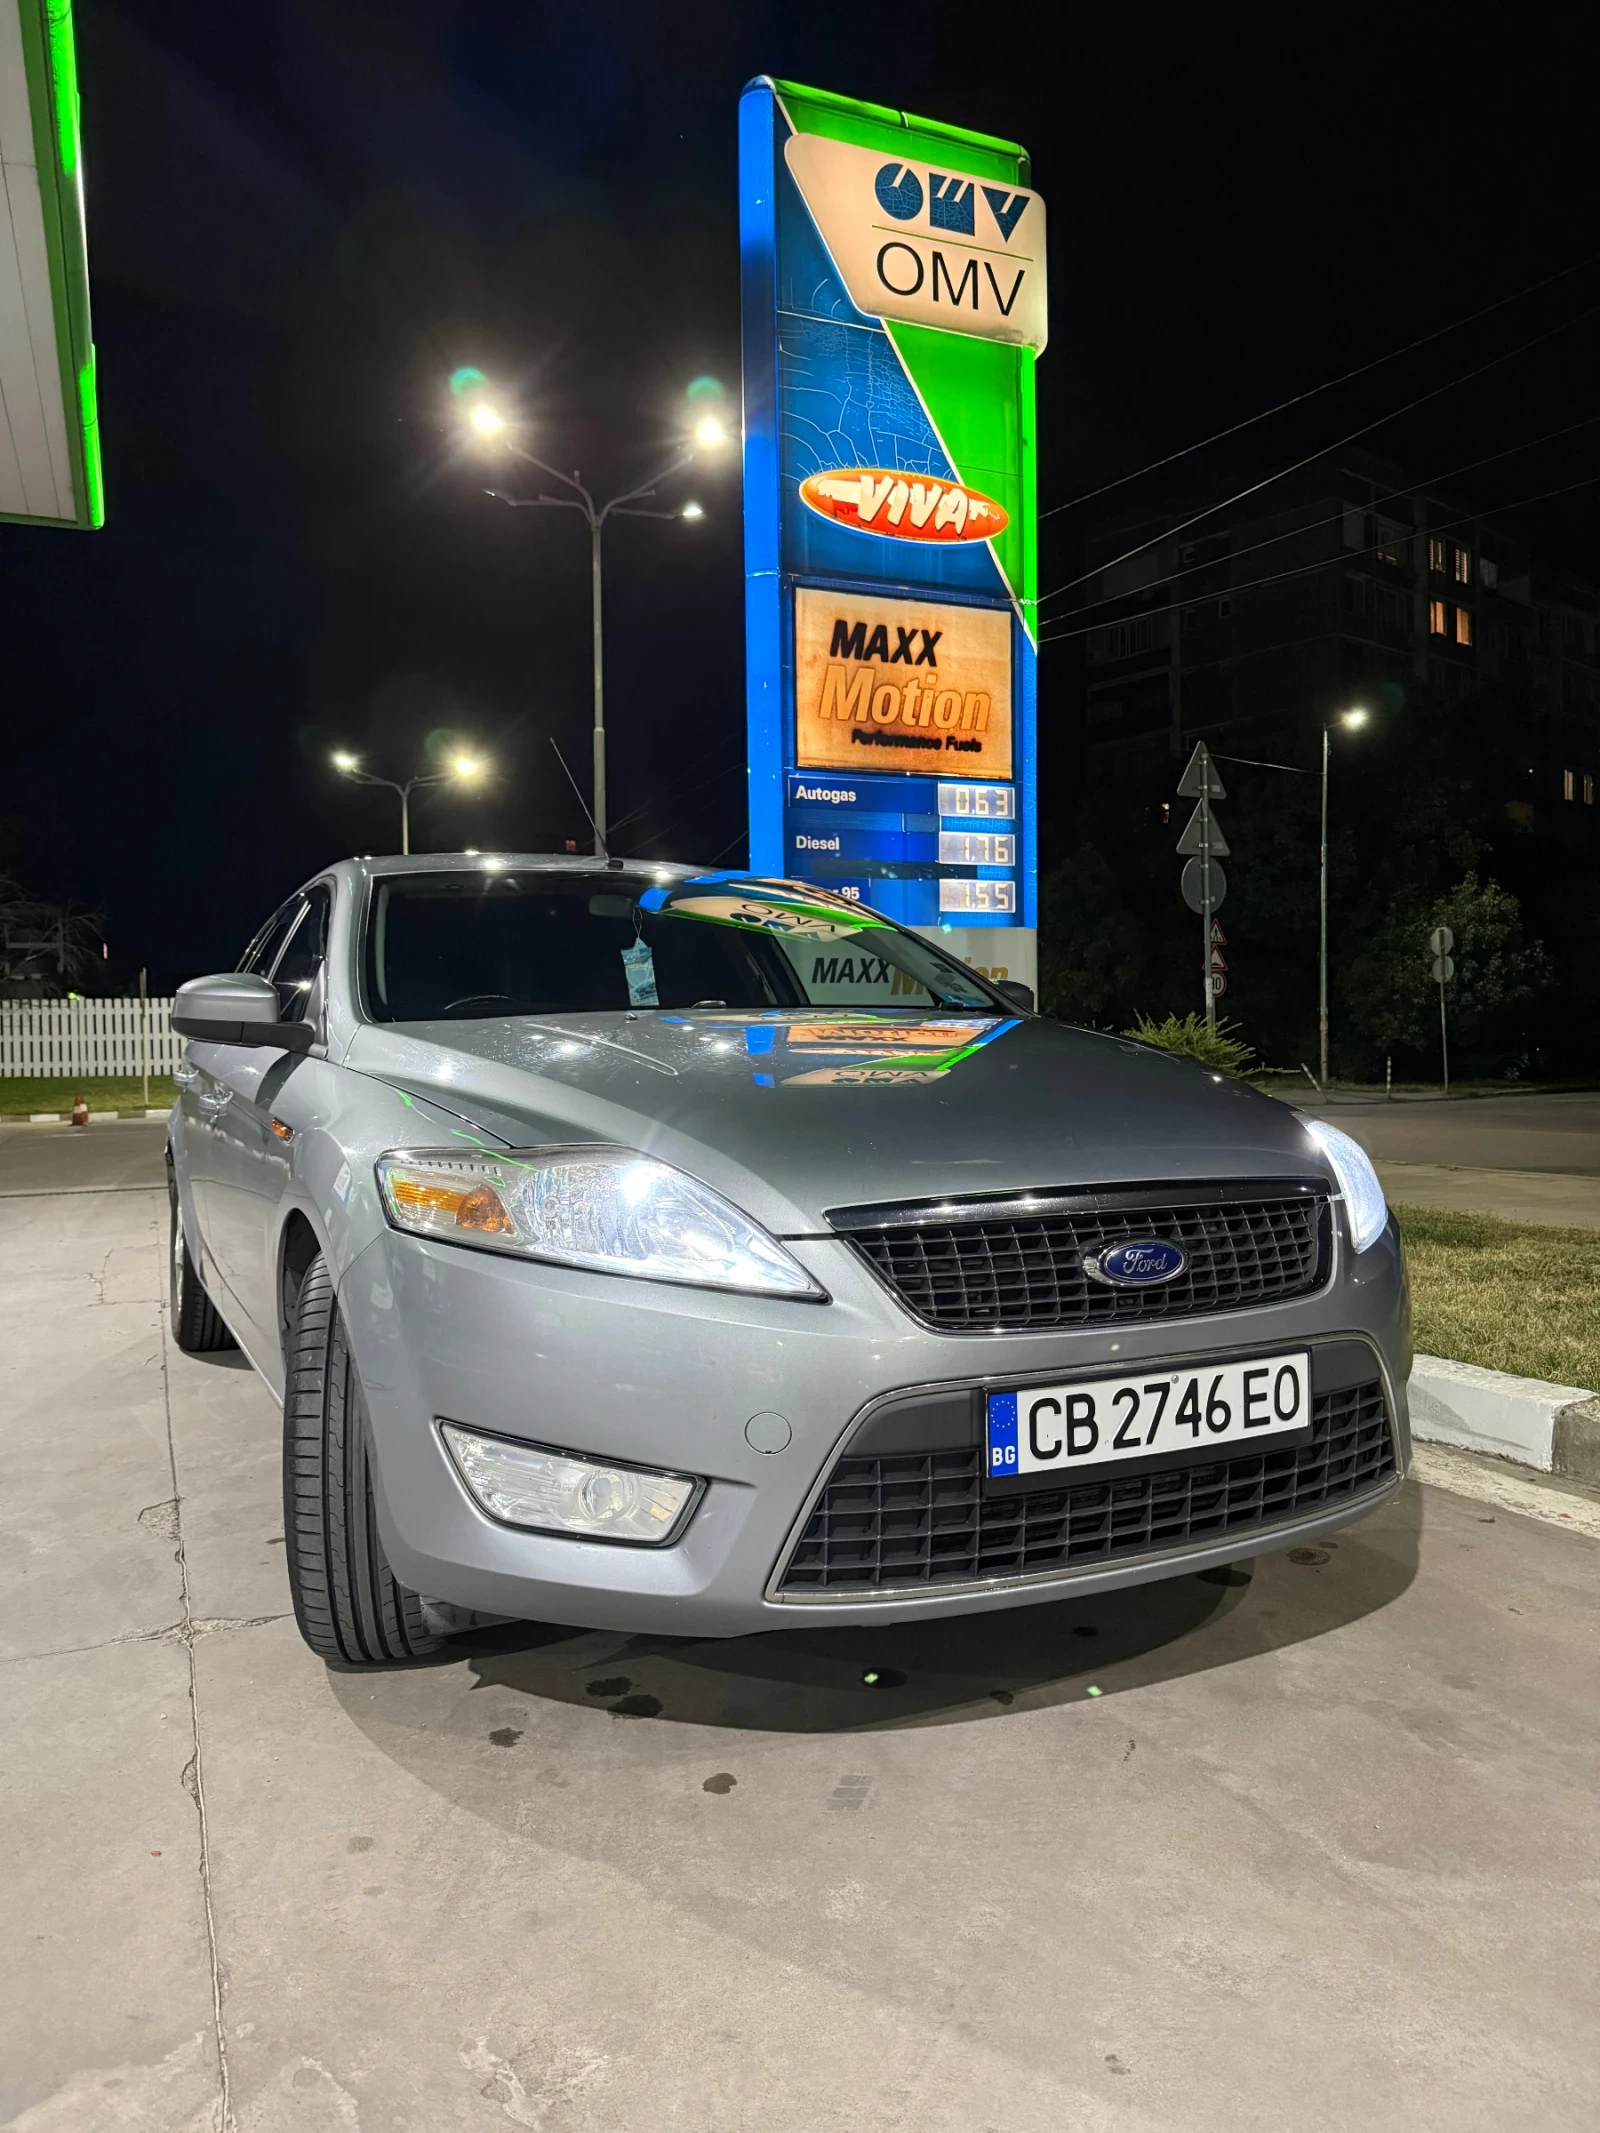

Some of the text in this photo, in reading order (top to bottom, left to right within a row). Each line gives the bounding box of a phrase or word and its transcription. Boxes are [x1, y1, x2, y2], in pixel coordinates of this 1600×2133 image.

[876, 242, 1026, 317] OMV
[858, 474, 969, 535] VIVA
[829, 619, 943, 667] MAXX
[819, 664, 992, 732] Motion
[945, 736, 982, 752] Fuels
[795, 785, 857, 803] Autogas
[795, 835, 840, 851] Diesel
[841, 886, 860, 900] 95
[811, 957, 891, 984] MAXX
[1123, 1248, 1168, 1273] Ford
[1029, 1364, 1300, 1460] CB 2746 EO
[992, 1445, 1016, 1467] BG
